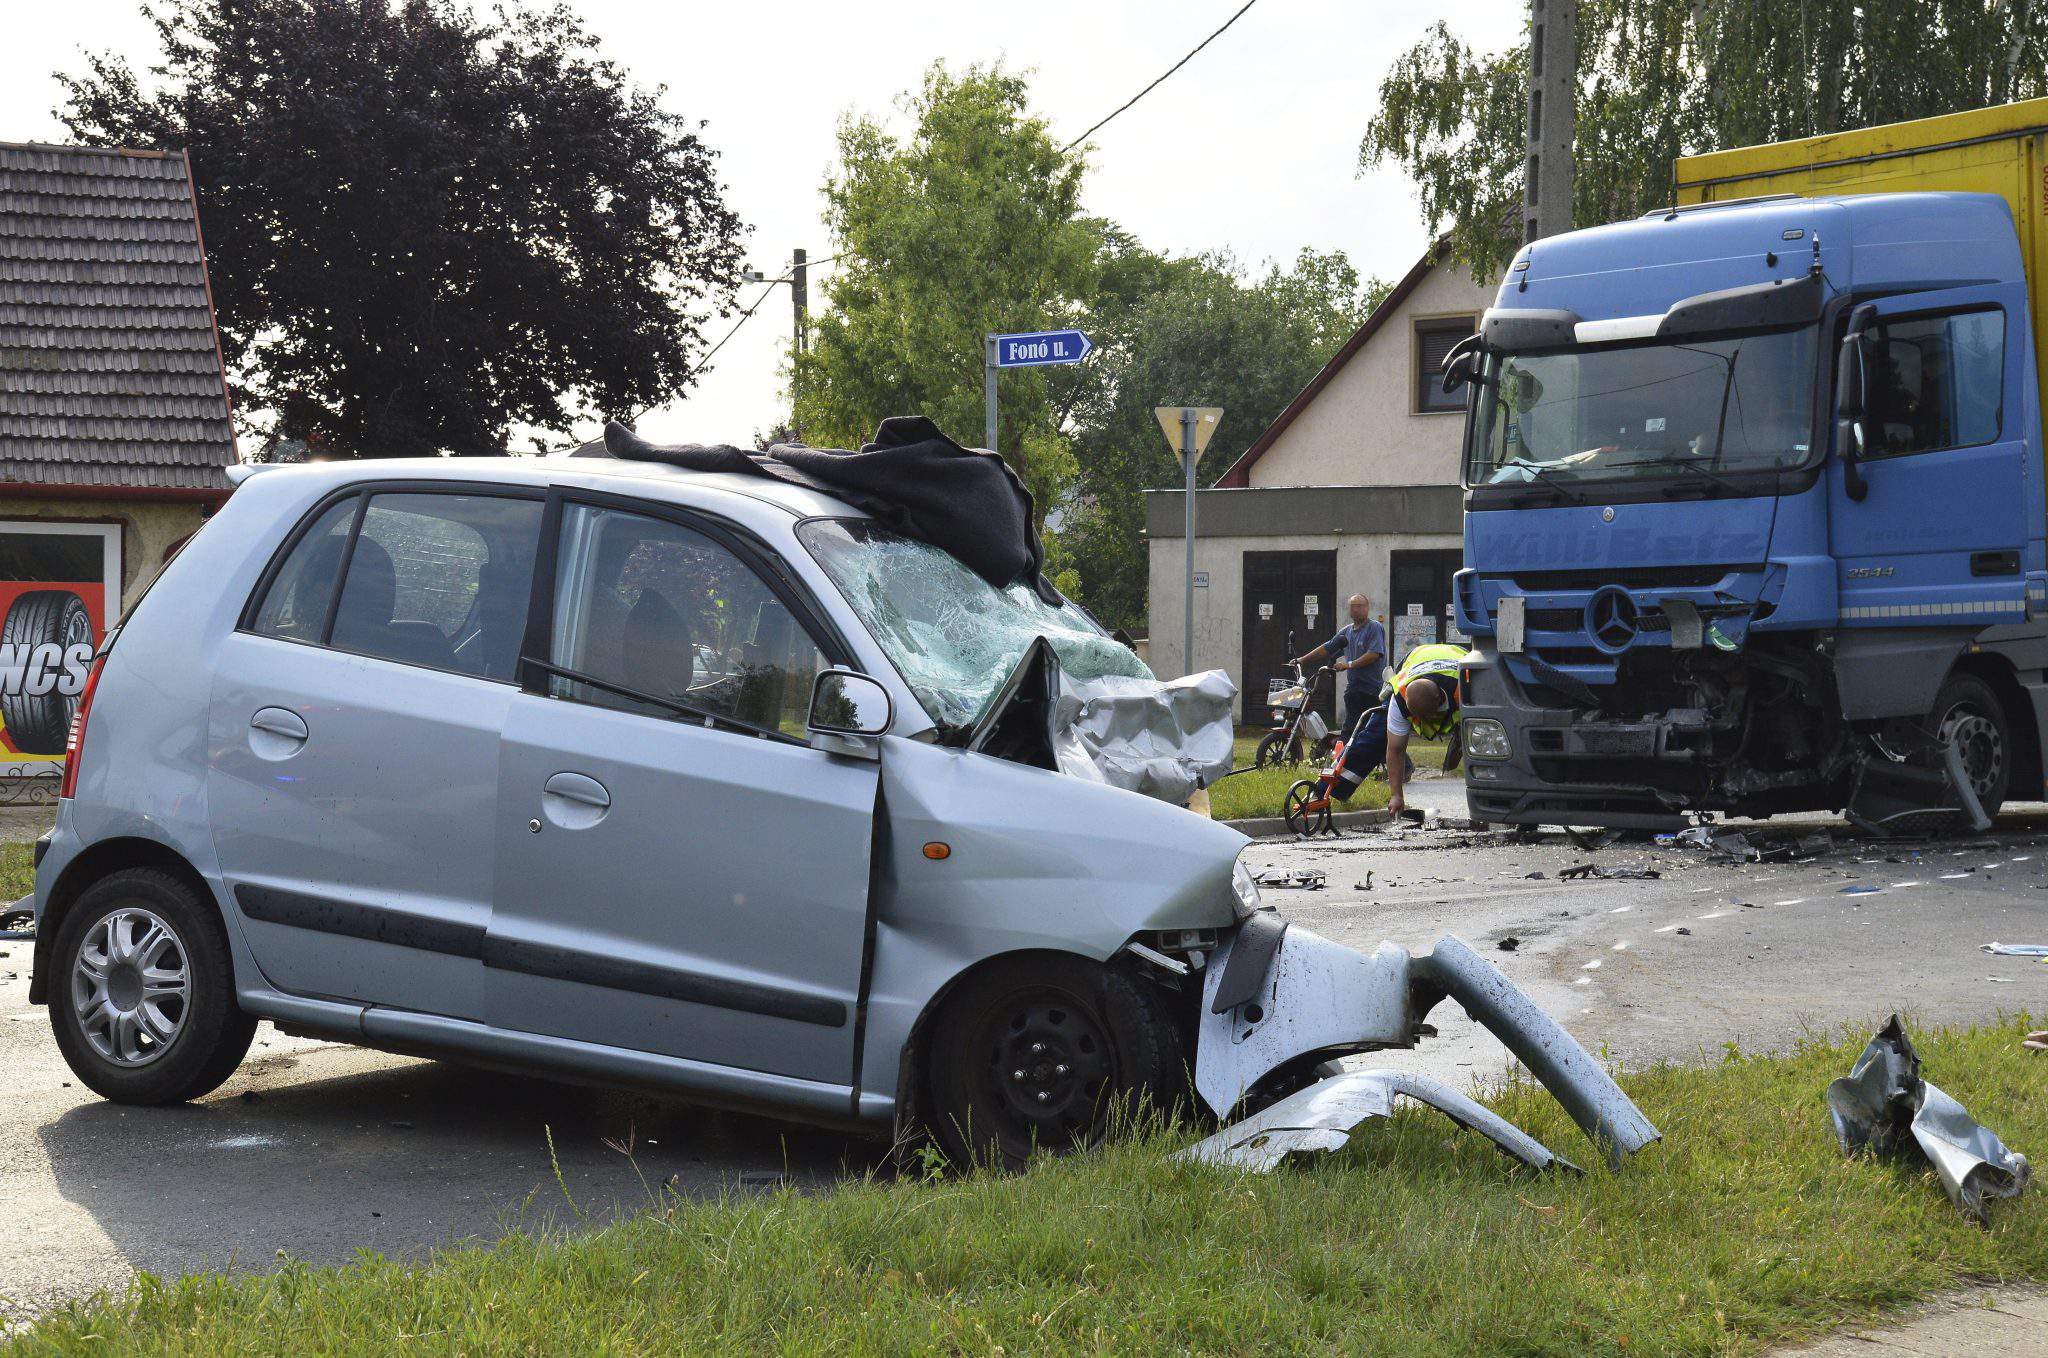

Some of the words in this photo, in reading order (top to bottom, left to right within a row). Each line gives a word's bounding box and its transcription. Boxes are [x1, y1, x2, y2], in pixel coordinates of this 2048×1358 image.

[1009, 339, 1048, 361] Fonó
[1054, 341, 1069, 357] u.
[1848, 567, 1895, 579] 2544
